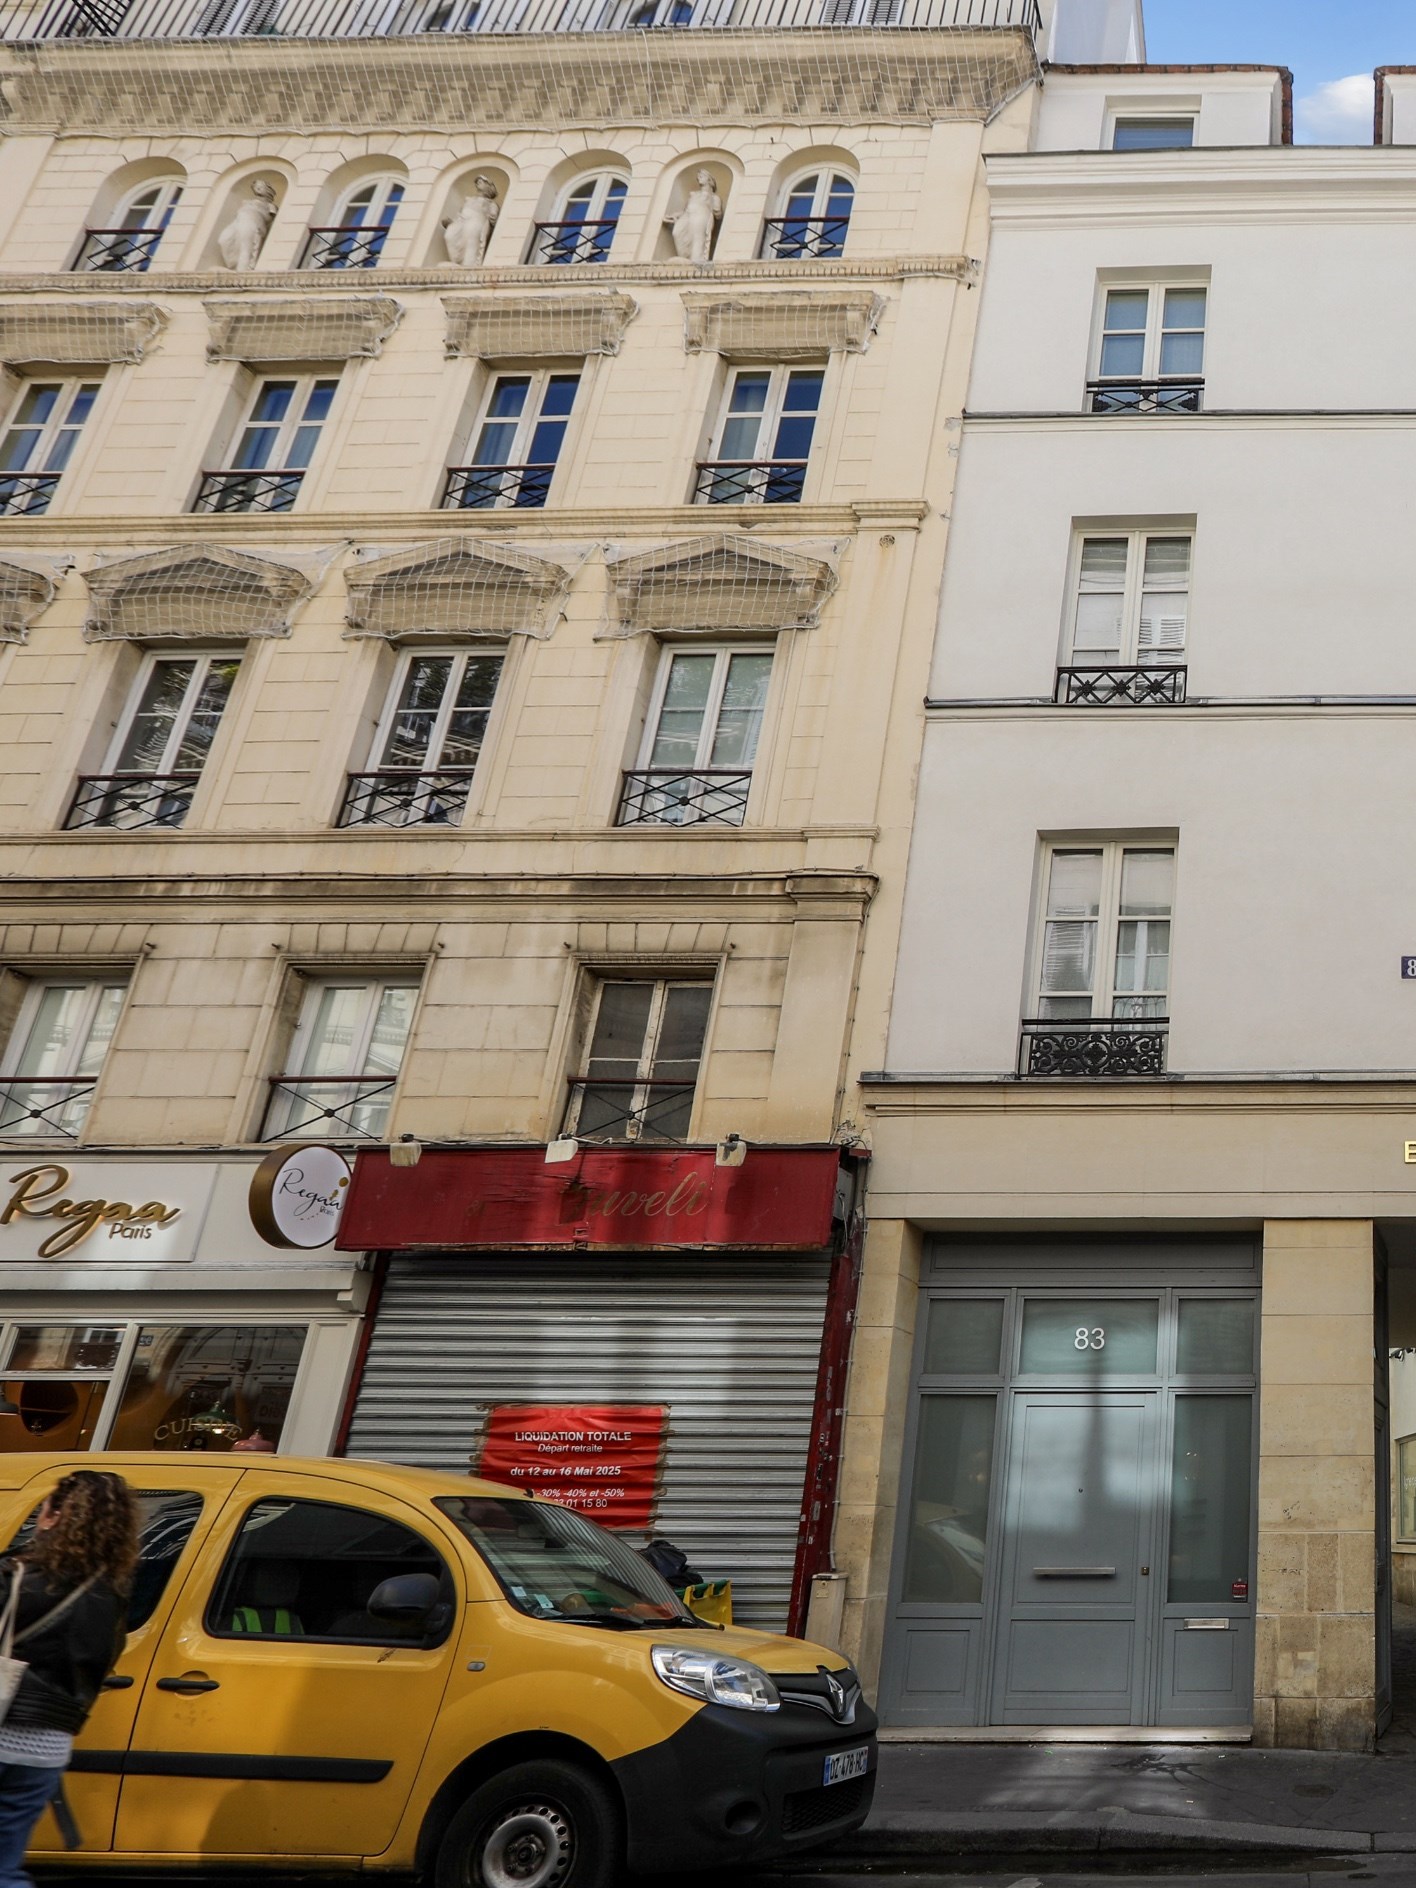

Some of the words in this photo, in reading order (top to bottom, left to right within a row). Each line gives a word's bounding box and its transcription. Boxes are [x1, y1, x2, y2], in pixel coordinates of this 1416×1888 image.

[279, 1168, 343, 1216] Regaa
[0, 1164, 180, 1258] Regaa
[109, 1223, 152, 1239] Paris
[1074, 1327, 1105, 1350] 83
[515, 1432, 584, 1442] LIQUIDATION
[587, 1431, 632, 1441] TOTALE
[538, 1444, 570, 1454] Départ
[571, 1444, 603, 1453] retraite
[510, 1466, 525, 1476] du
[528, 1466, 540, 1476] 12
[542, 1468, 556, 1476] au
[559, 1466, 572, 1475] 16
[574, 1466, 593, 1475] Mai
[597, 1466, 621, 1475] 2025
[536, 1488, 561, 1497] -30%
[563, 1488, 587, 1497] -40%
[589, 1488, 599, 1497] et
[600, 1488, 625, 1497] -50%
[581, 1499, 593, 1508] 15
[595, 1498, 608, 1508] 80
